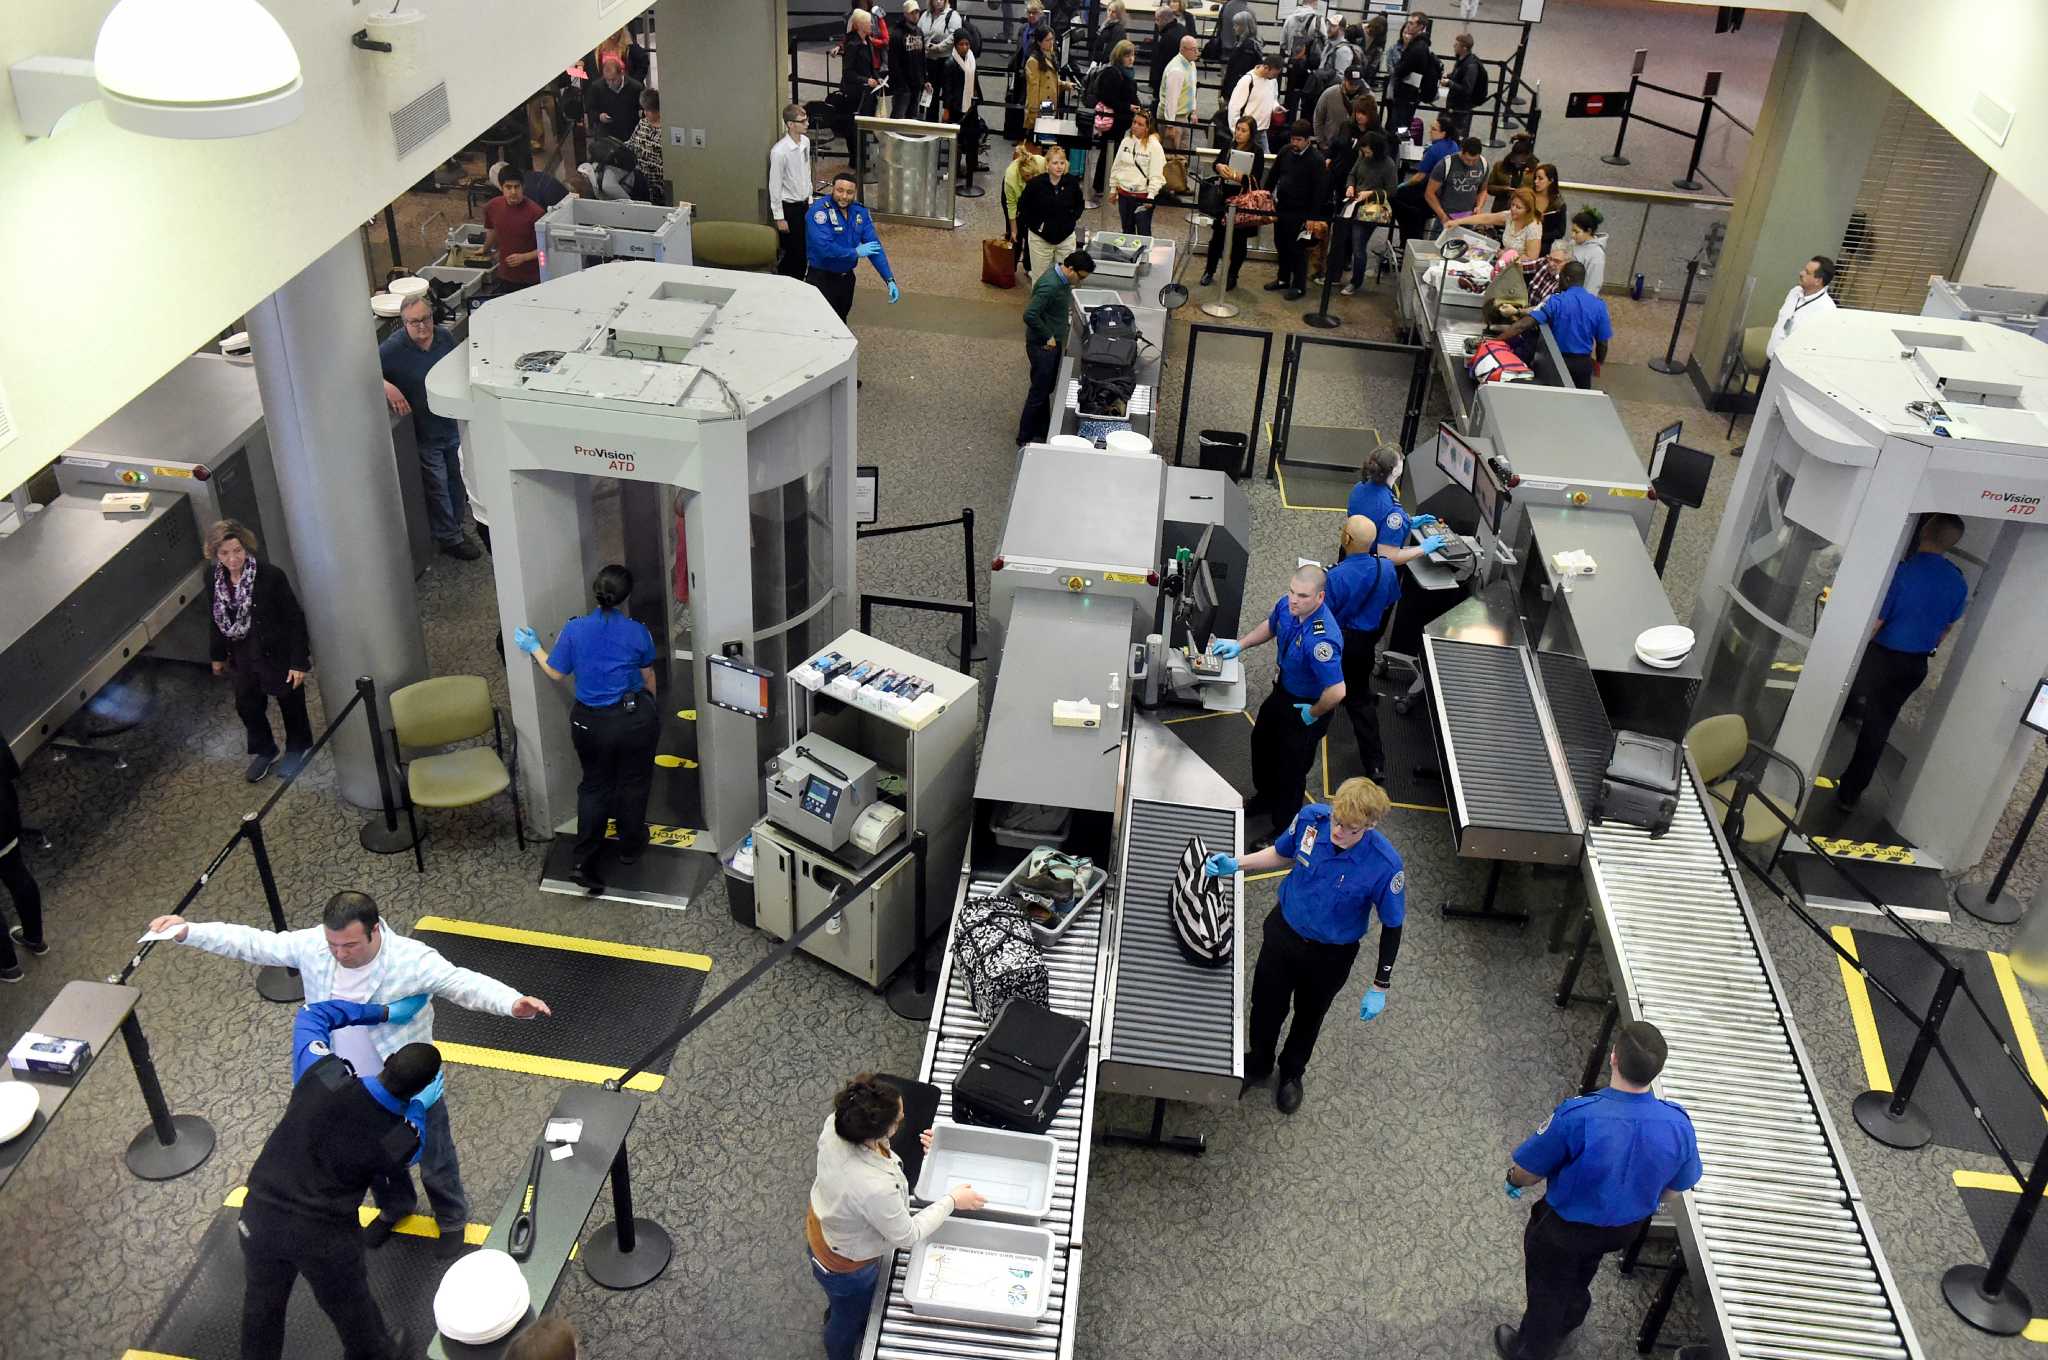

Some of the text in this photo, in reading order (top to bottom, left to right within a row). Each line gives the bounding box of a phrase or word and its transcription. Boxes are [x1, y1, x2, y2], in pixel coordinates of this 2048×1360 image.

[574, 445, 634, 461] ProVision
[608, 460, 635, 472] ATD
[1981, 490, 2041, 505] ProVision
[2006, 504, 2036, 515] ATD
[652, 831, 691, 842] WATCH
[1871, 848, 1911, 858] WATCH
